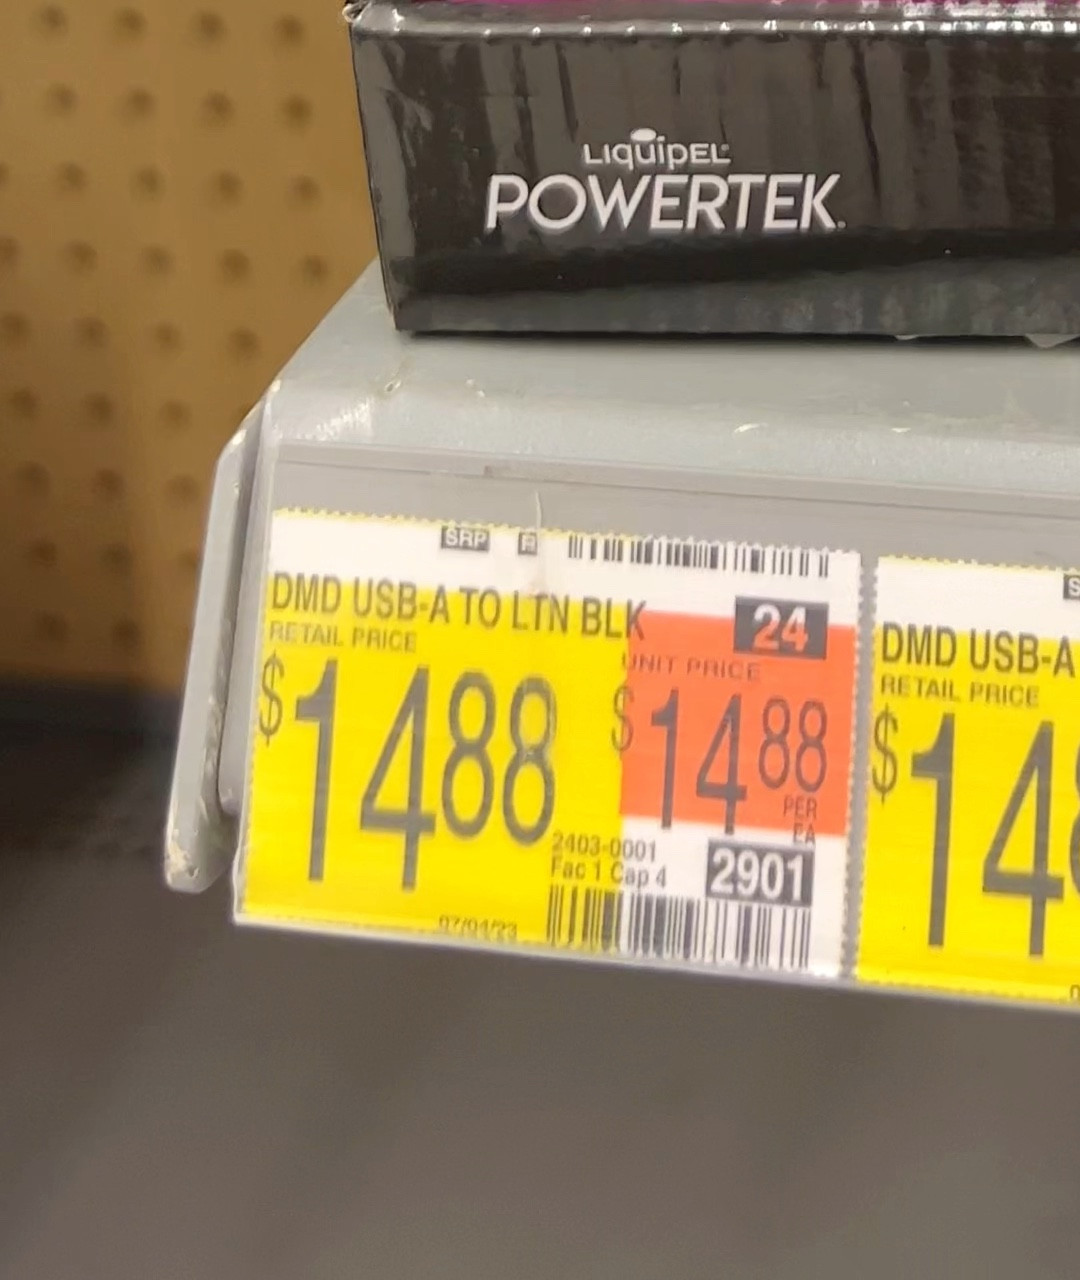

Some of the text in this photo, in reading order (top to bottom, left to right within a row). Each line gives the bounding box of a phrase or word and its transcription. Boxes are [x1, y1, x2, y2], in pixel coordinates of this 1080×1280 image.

[484, 173, 847, 232] POWERTEK
[443, 526, 489, 550] SRP
[271, 571, 647, 640] DMD USB-A TO LTN BLK
[269, 620, 418, 654] RETAIL PRICE
[750, 603, 810, 653] 24
[621, 652, 762, 682] UNIT PRICE
[881, 620, 958, 668] DMD
[968, 627, 1076, 679] USB-A
[880, 673, 1040, 709] RETAIL PRICE
[783, 794, 818, 819] PER
[551, 831, 657, 863] 2403-0001
[551, 858, 668, 888] Fac 1 Cap 4
[709, 848, 806, 903] 2901
